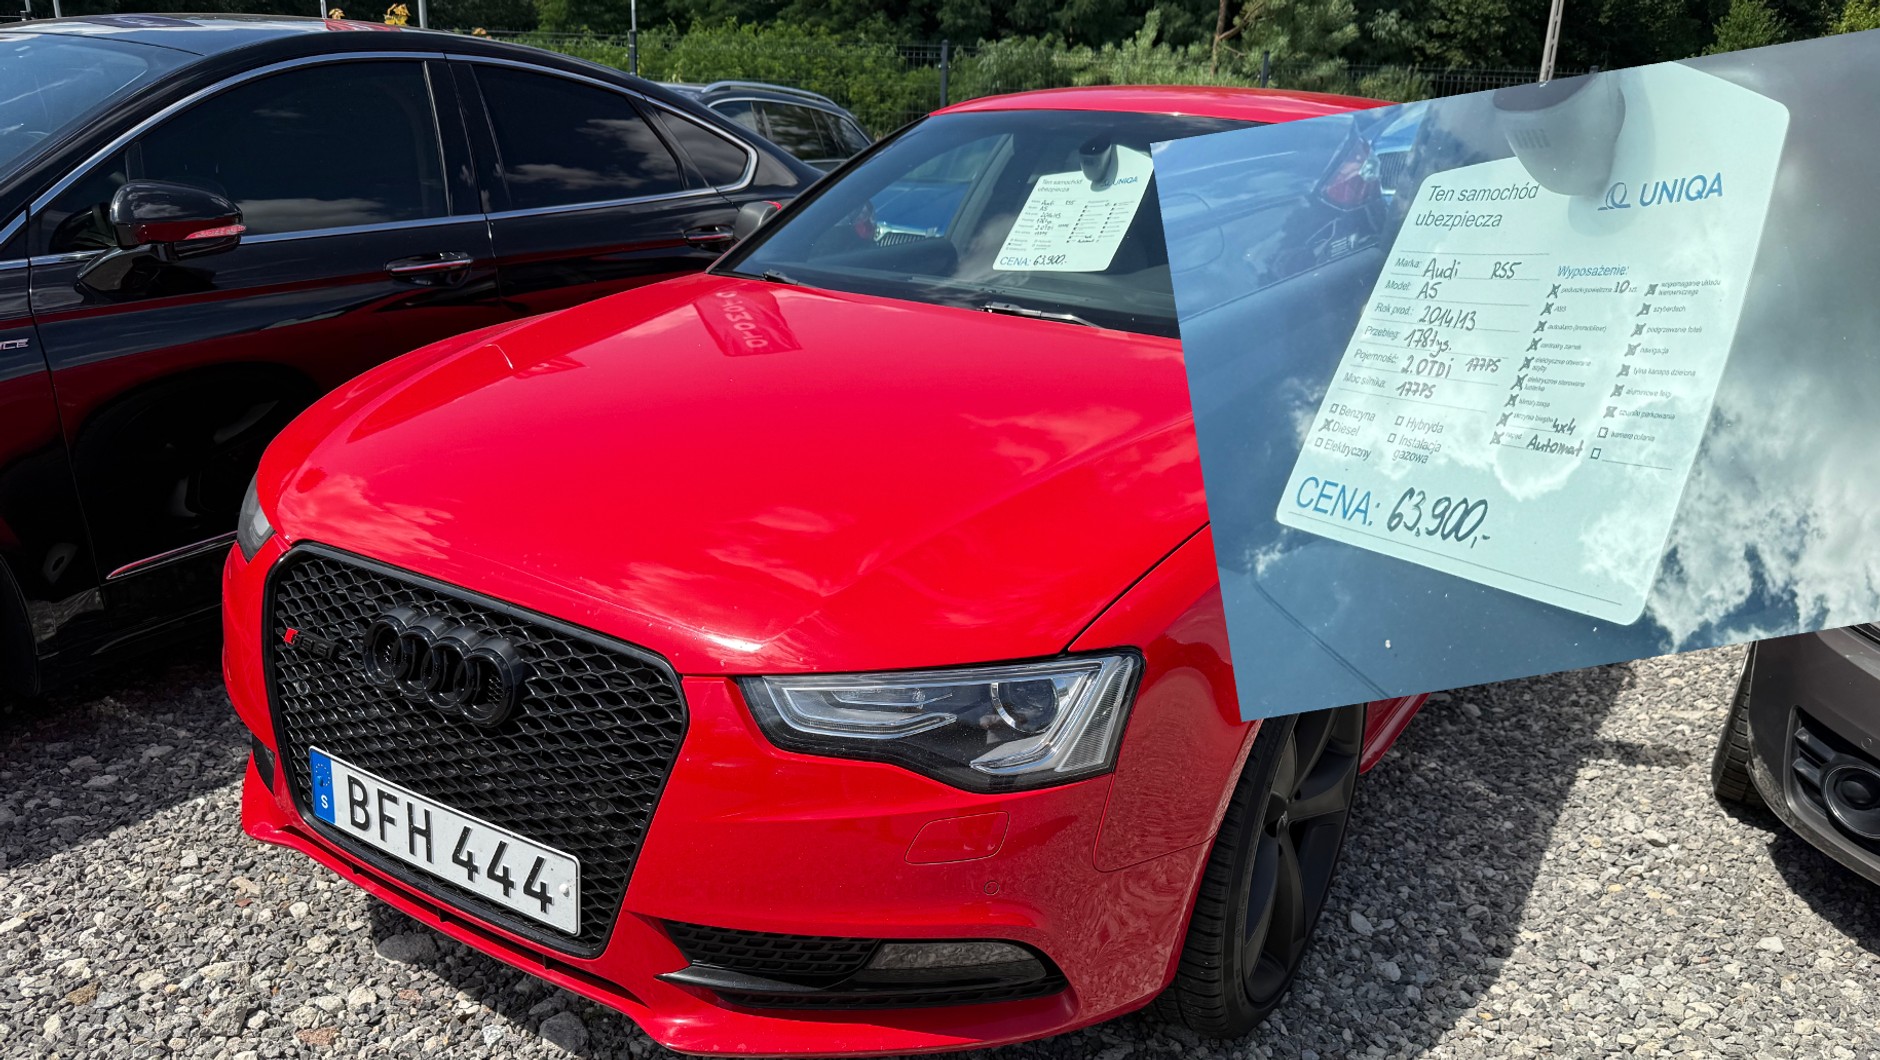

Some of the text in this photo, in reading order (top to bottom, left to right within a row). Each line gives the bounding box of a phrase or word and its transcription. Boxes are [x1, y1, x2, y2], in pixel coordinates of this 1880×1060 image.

[1428, 182, 1541, 202] Ten samochód
[1640, 172, 1723, 207] UNIQA
[1415, 210, 1503, 231] ubezpiecza
[1000, 256, 1031, 267] CENA:
[1395, 257, 1422, 269] Marka:
[1422, 257, 1461, 281] Audi
[1557, 264, 1629, 280] Wyposażenie:
[1384, 279, 1442, 299] Model: A5
[1614, 280, 1630, 294] 10
[1374, 302, 1391, 313] Rok
[0, 338, 29, 350] CE
[1342, 372, 1361, 383] Moc
[1339, 404, 1376, 422] Benzyna
[1332, 421, 1361, 437] Diesel
[1405, 416, 1444, 434] Hybryda
[1324, 438, 1371, 461] Elektryczny
[1399, 434, 1442, 454] Instalacja
[1526, 433, 1585, 458] Automat
[1392, 448, 1430, 464] gazowa
[1296, 476, 1381, 527] CENA:
[320, 794, 329, 809] S
[346, 774, 554, 914] BFH 444
